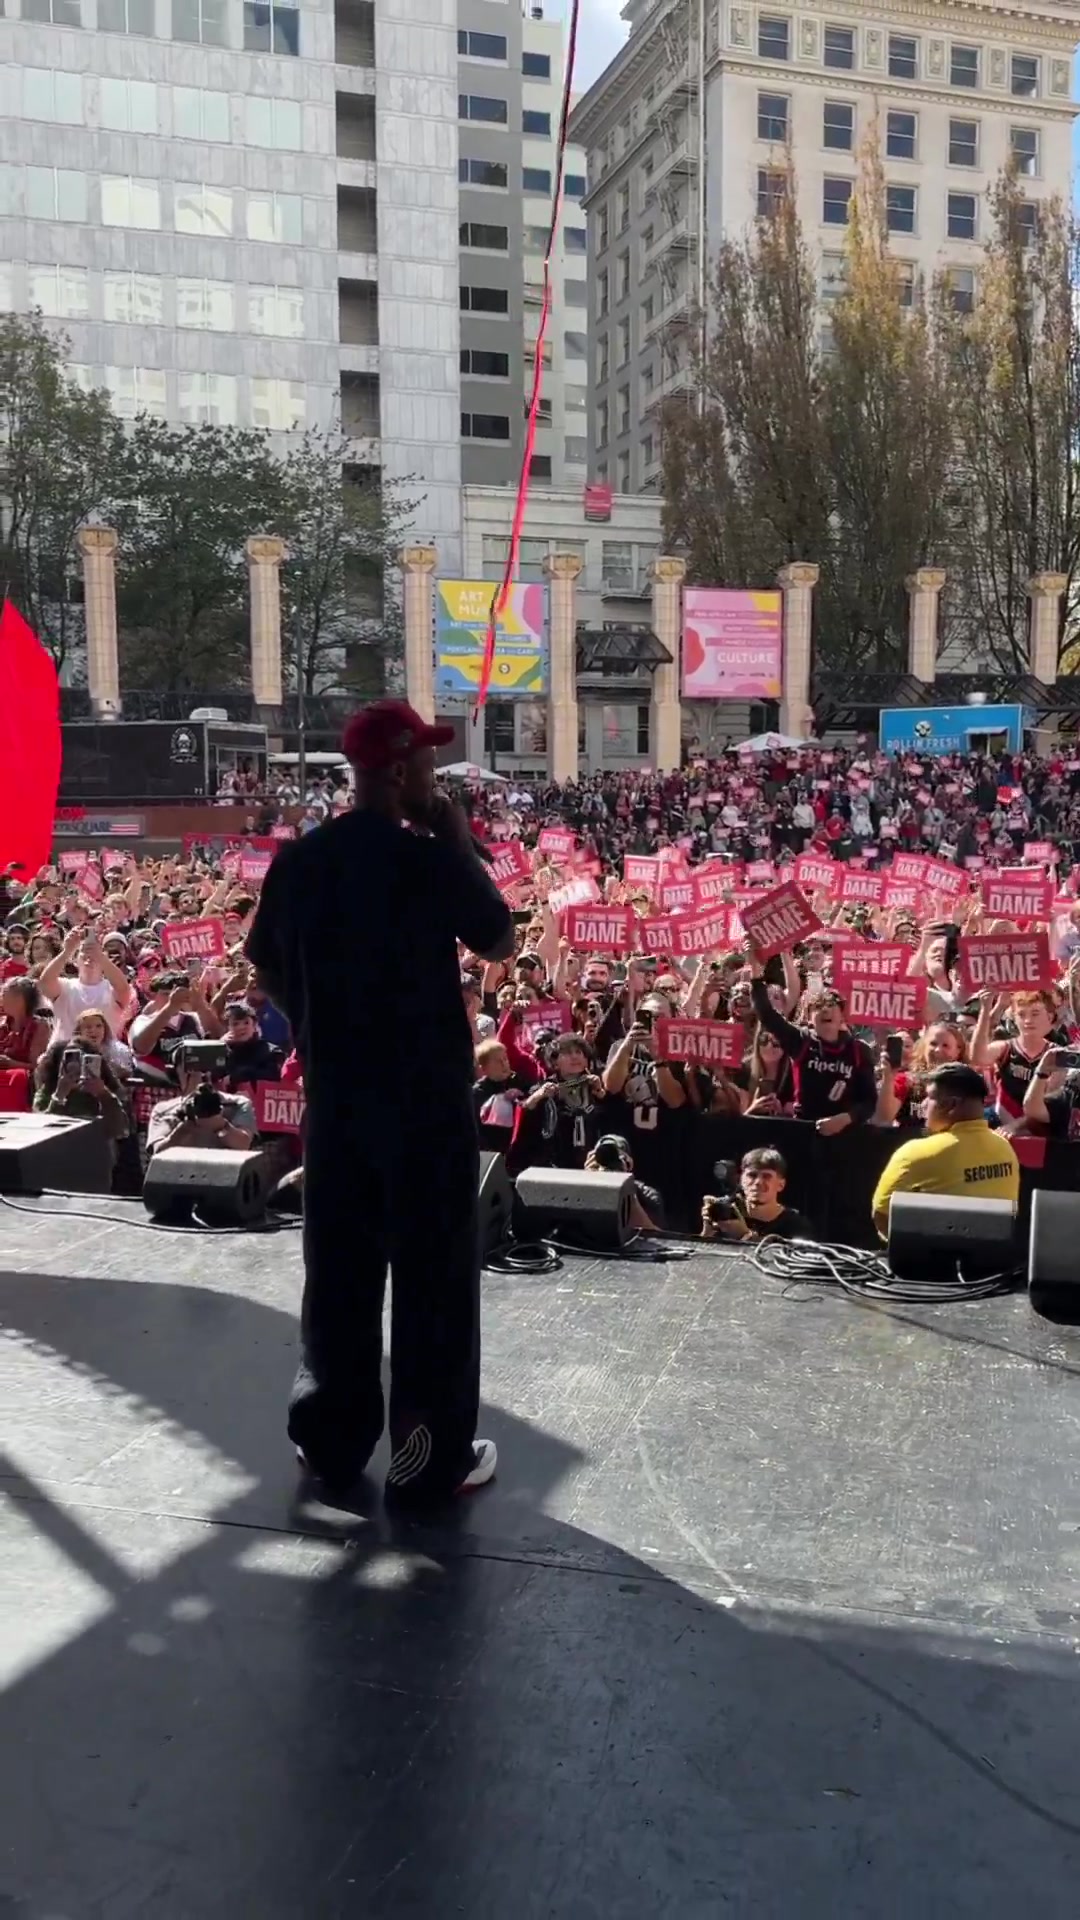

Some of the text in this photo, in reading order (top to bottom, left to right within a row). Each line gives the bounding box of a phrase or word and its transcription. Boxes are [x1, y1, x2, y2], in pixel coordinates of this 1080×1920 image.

[459, 591, 484, 602] ART
[717, 652, 775, 664] CULTURE
[926, 737, 960, 749] FRESH
[485, 856, 521, 881] AME
[800, 866, 834, 887] DAME
[843, 881, 882, 899] DAME
[926, 870, 960, 892] DAME
[989, 894, 1045, 916] DAME
[573, 921, 628, 943] DAME
[680, 920, 725, 951] DAME
[749, 902, 810, 948] DAME
[169, 932, 216, 957] DAME
[968, 953, 1041, 984] DAME
[849, 990, 917, 1021] DAME
[667, 1032, 733, 1060] DAME
[808, 1057, 854, 1079] ripcity
[828, 1080, 847, 1101] 0
[963, 1162, 1013, 1183] SECURITY
